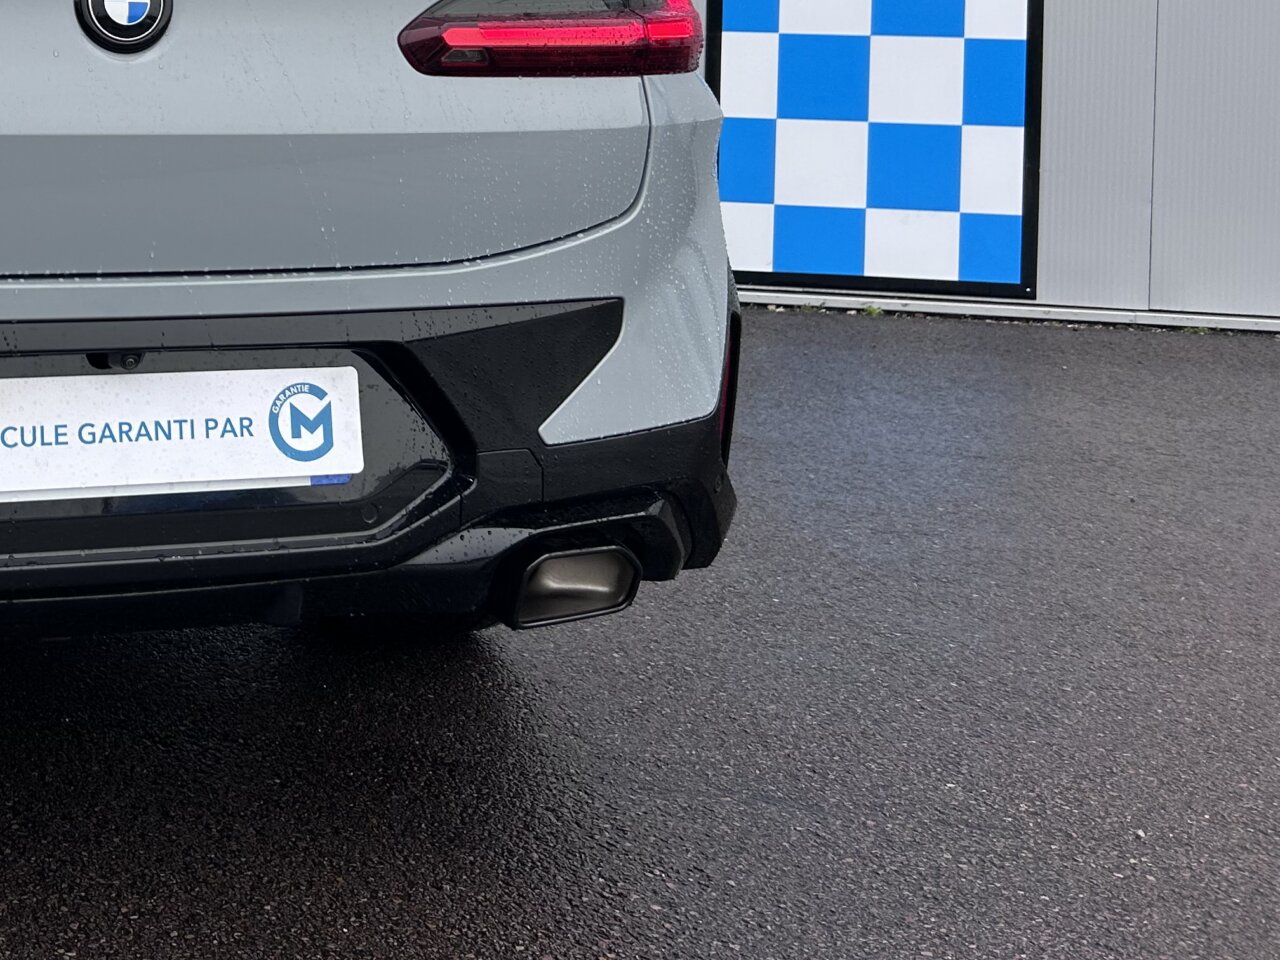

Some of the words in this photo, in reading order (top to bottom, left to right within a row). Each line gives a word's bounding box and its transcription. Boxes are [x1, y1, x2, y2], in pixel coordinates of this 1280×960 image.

[272, 384, 310, 414] GARANTIE
[78, 419, 195, 444] GARANTI
[205, 417, 254, 438] PAR
